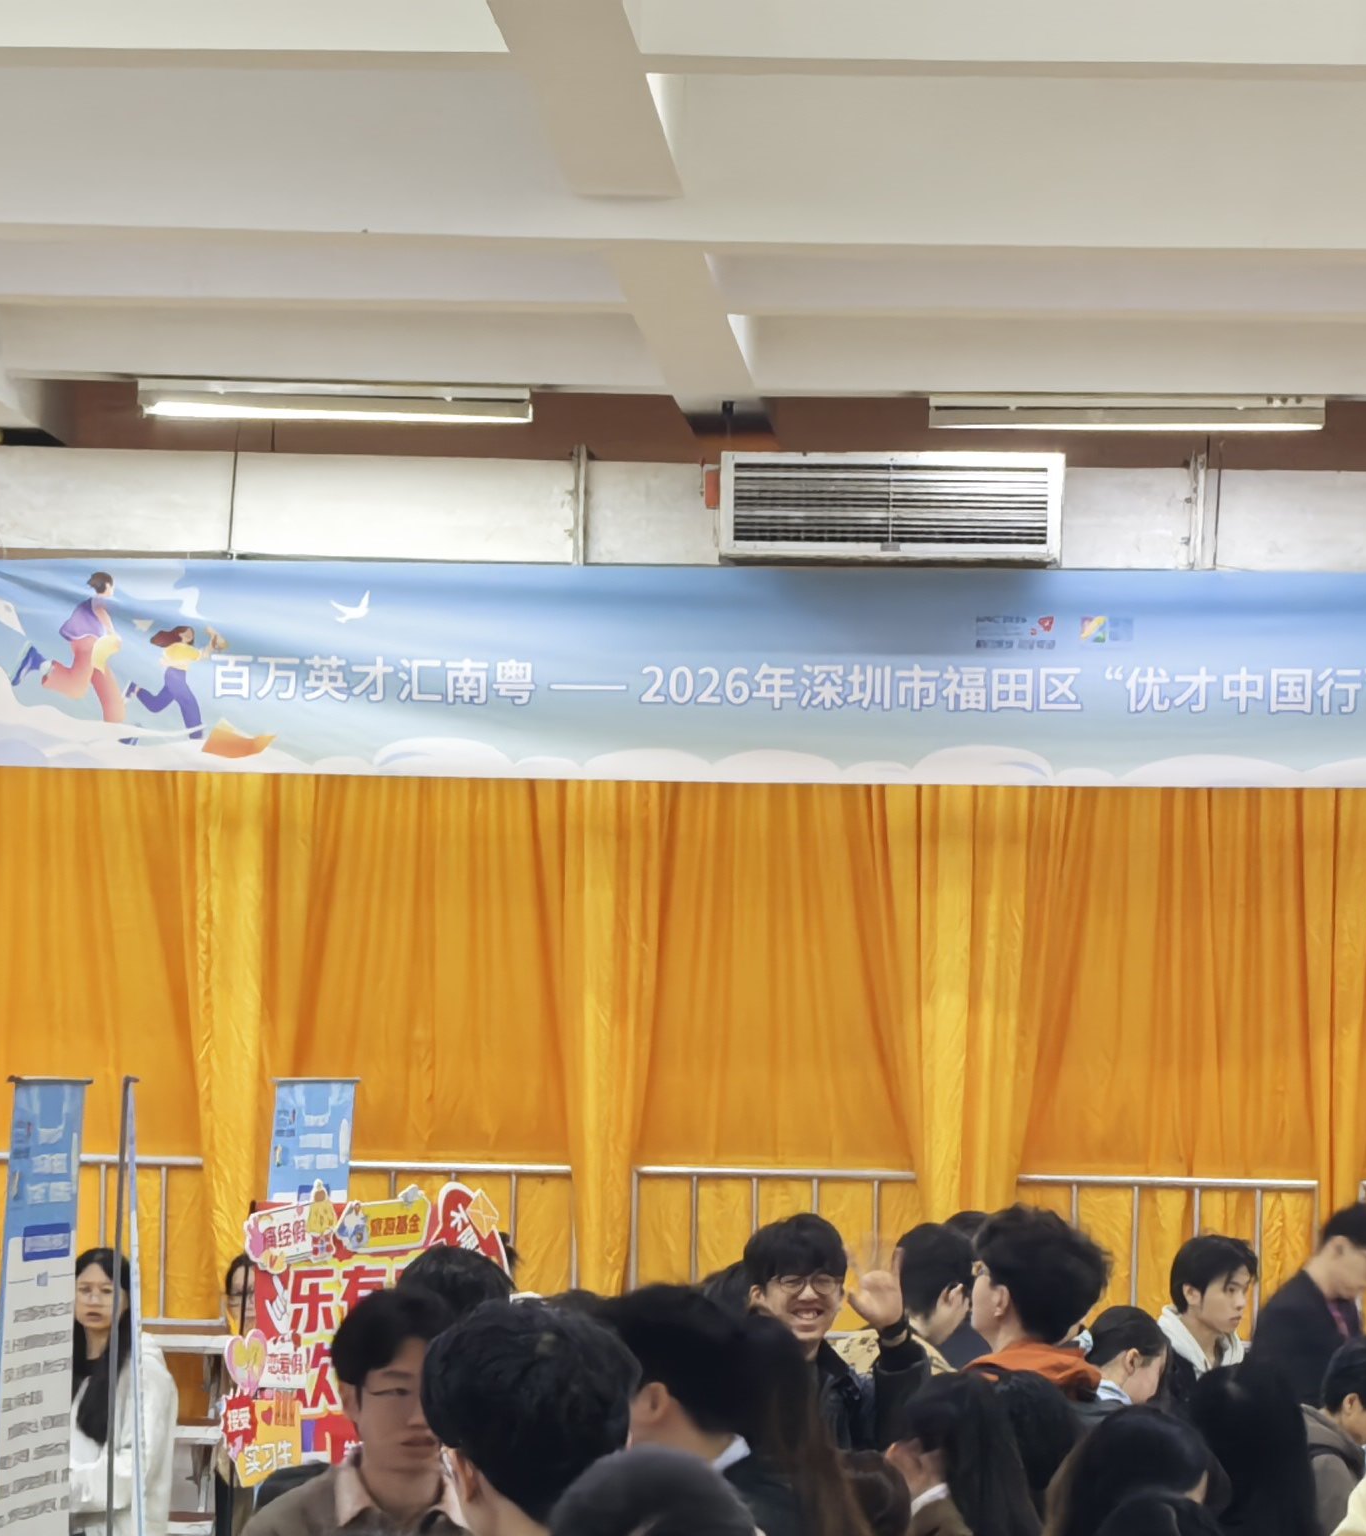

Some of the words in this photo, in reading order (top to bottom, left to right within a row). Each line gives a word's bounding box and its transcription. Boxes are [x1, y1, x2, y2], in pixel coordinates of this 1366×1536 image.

[211, 653, 536, 705] 百万英才汇南粤
[244, 1440, 294, 1473] 实习生
